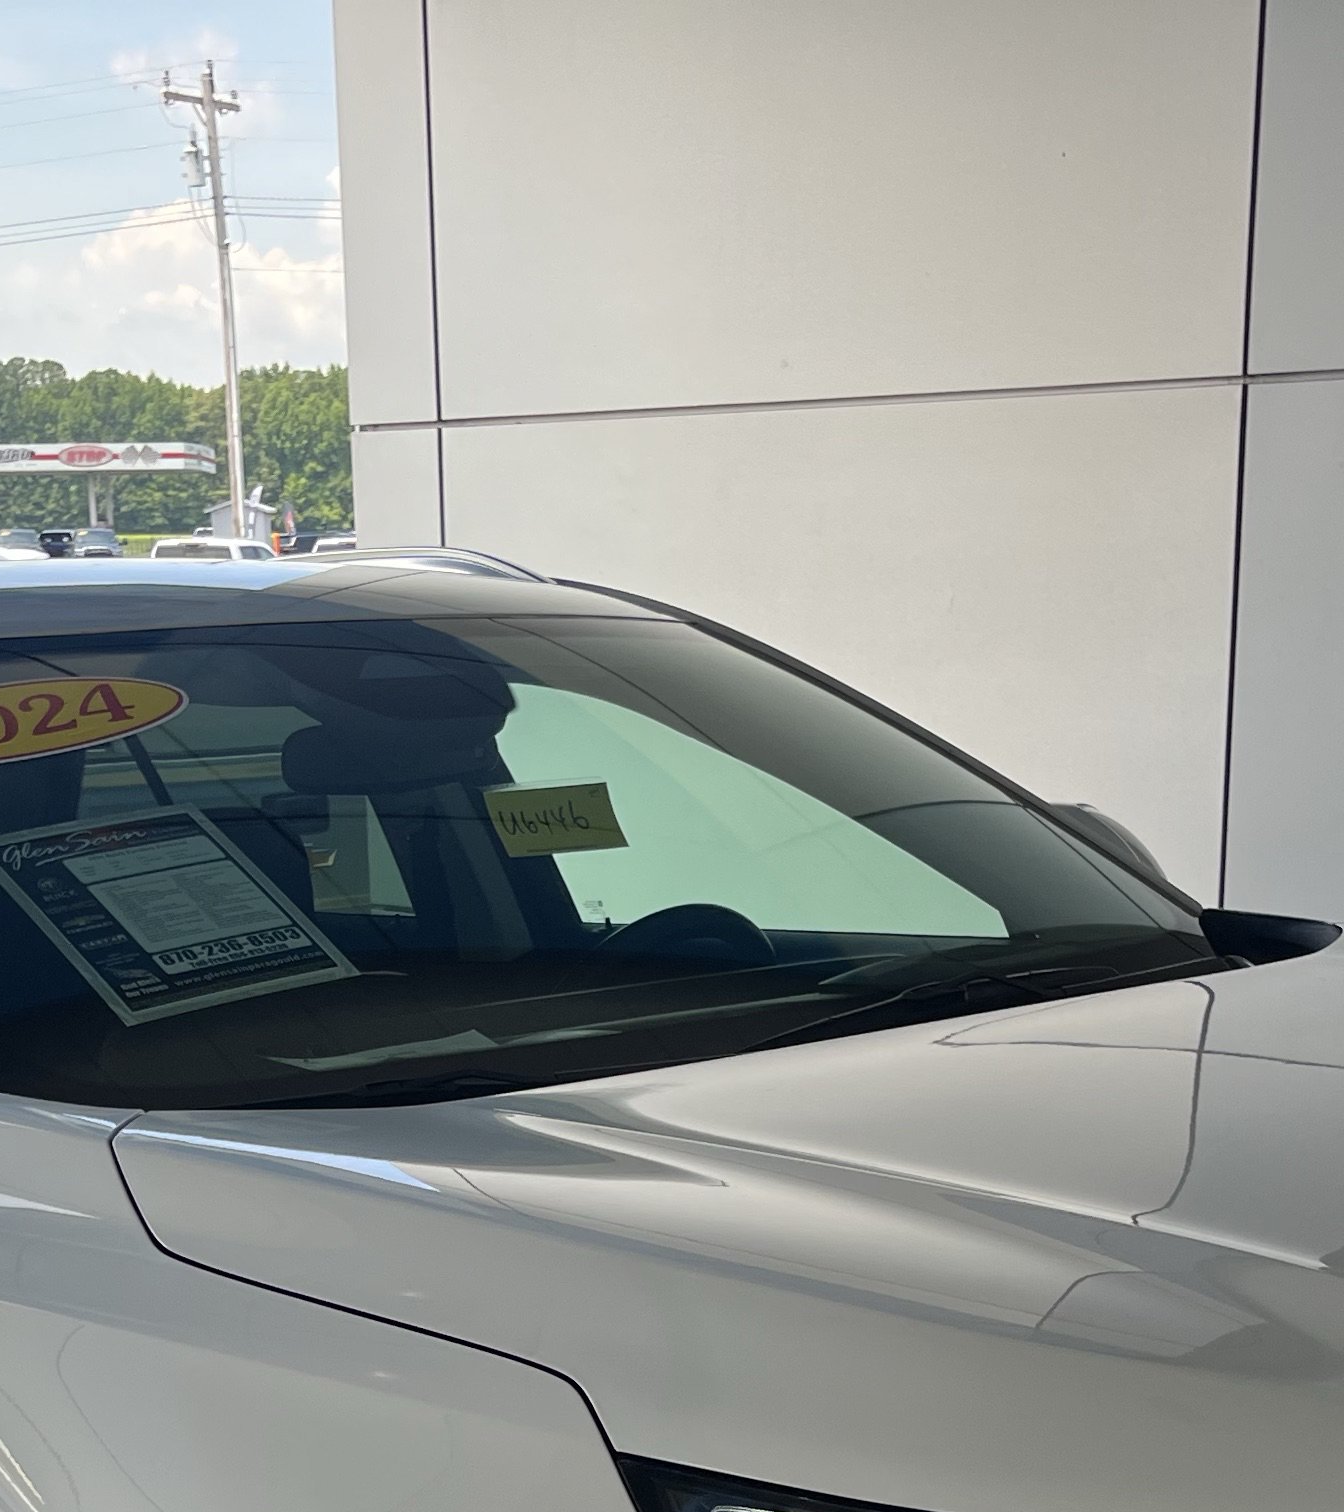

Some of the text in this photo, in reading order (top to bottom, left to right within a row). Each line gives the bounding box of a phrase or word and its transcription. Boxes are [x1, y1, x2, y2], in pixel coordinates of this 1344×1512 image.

[2, 843, 70, 871] Glen
[65, 831, 147, 856] Sain
[158, 927, 302, 966] 870-236-8503
